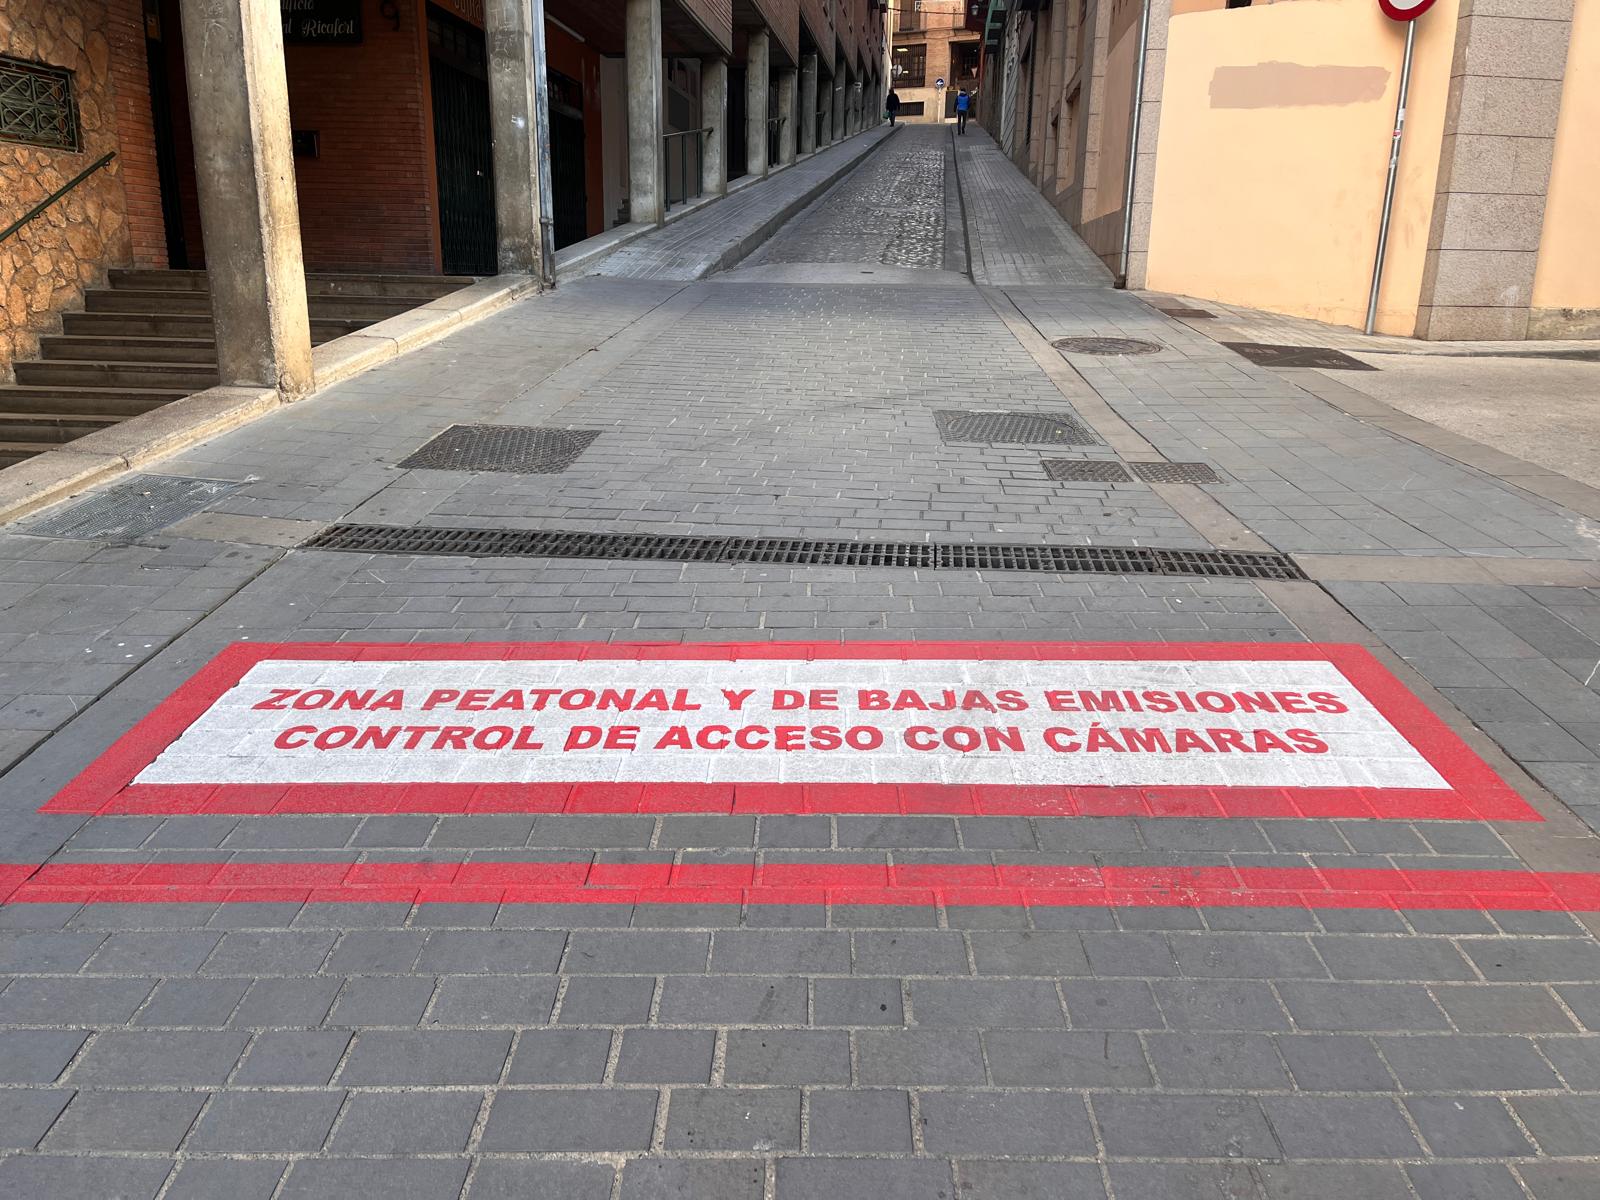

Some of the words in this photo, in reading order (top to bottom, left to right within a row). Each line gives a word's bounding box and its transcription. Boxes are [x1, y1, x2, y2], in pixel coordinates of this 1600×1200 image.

[302, 17, 355, 37] Ricafort
[250, 689, 404, 711] ZONA
[421, 689, 701, 712] PEATONAL
[721, 689, 756, 711] Y
[772, 690, 839, 711] DE
[858, 690, 1029, 713] BAJAS
[1043, 690, 1349, 714] EMISIONES
[273, 725, 543, 751] CONTROL
[564, 725, 640, 752] DE
[655, 725, 884, 752] ACCESO
[905, 726, 1026, 753] CON
[1042, 722, 1329, 754] CÁMARAS
